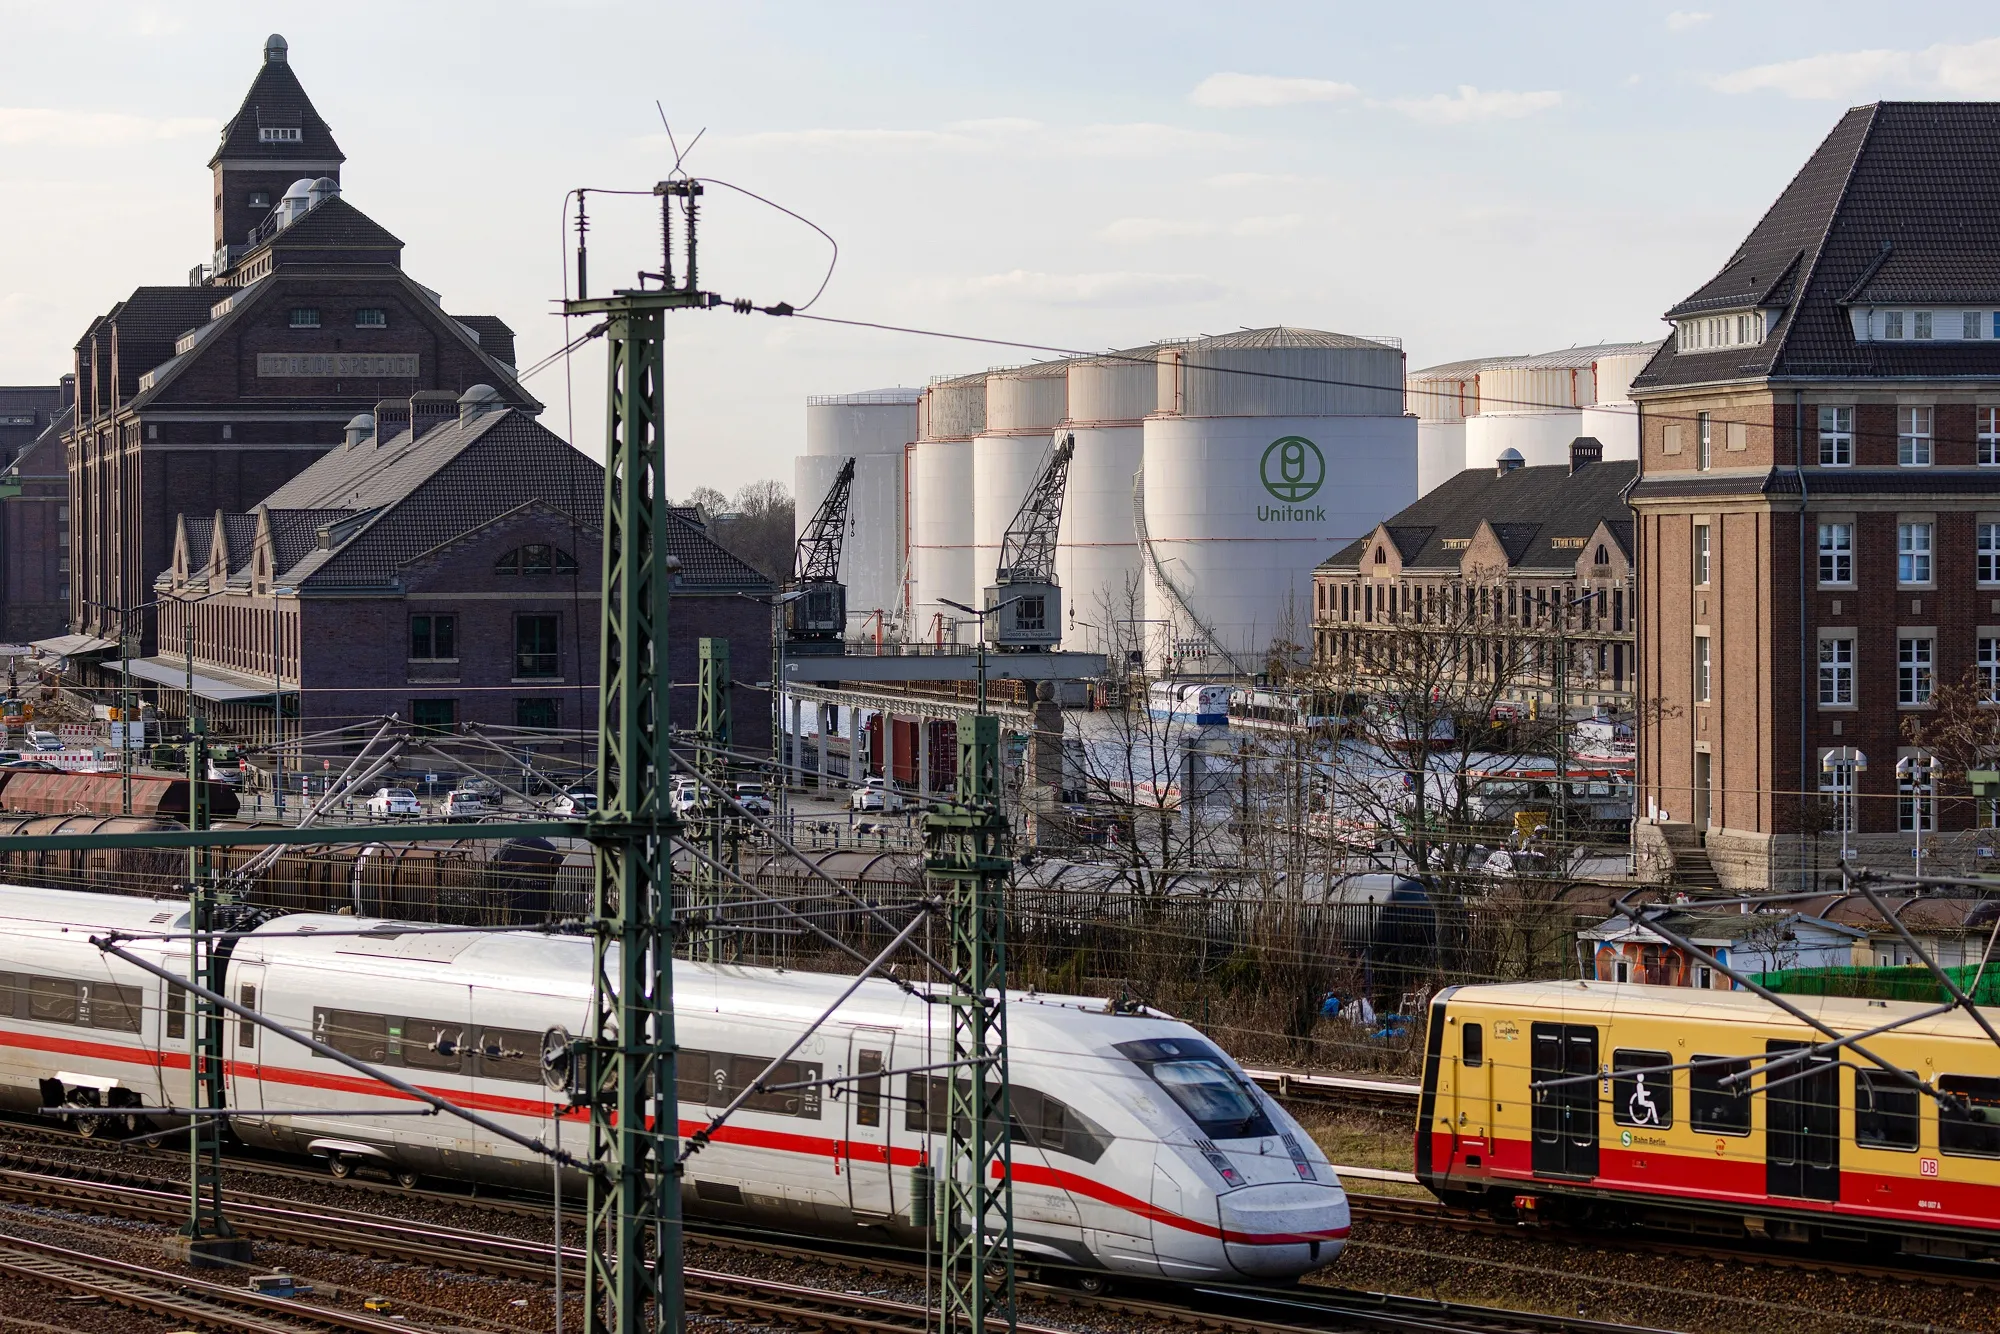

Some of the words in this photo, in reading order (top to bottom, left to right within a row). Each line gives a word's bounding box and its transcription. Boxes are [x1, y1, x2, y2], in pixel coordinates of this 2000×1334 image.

[261, 357, 334, 374] GETREIDE
[339, 357, 415, 374] SPEICHER
[1257, 505, 1326, 521] Unitank
[82, 986, 88, 1003] 2
[318, 1013, 325, 1031] 2
[808, 1069, 816, 1090] 2
[1622, 1131, 1631, 1146] S
[1634, 1136, 1648, 1144] Bahn
[1649, 1137, 1666, 1146] Berlin
[1922, 1161, 1936, 1173] DB
